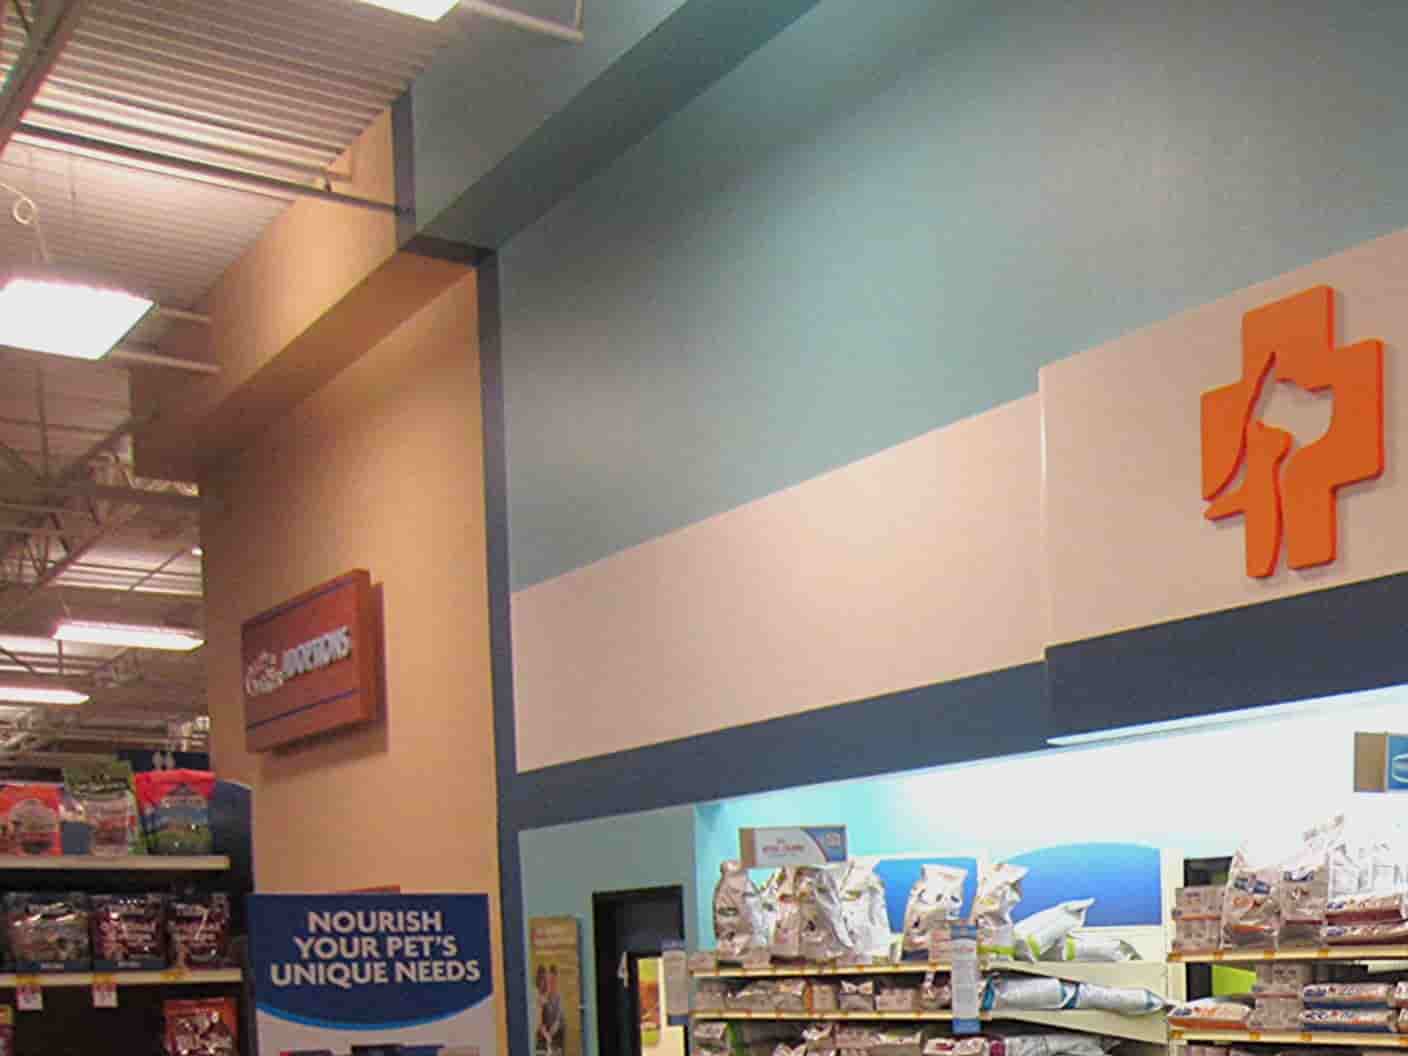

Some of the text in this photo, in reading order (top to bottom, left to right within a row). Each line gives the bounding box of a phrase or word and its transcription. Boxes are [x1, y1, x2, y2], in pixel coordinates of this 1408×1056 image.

[308, 910, 442, 933] NOURISH
[293, 935, 459, 960] YOUR PET'S
[271, 959, 482, 990] UNIQUE NEEDS
